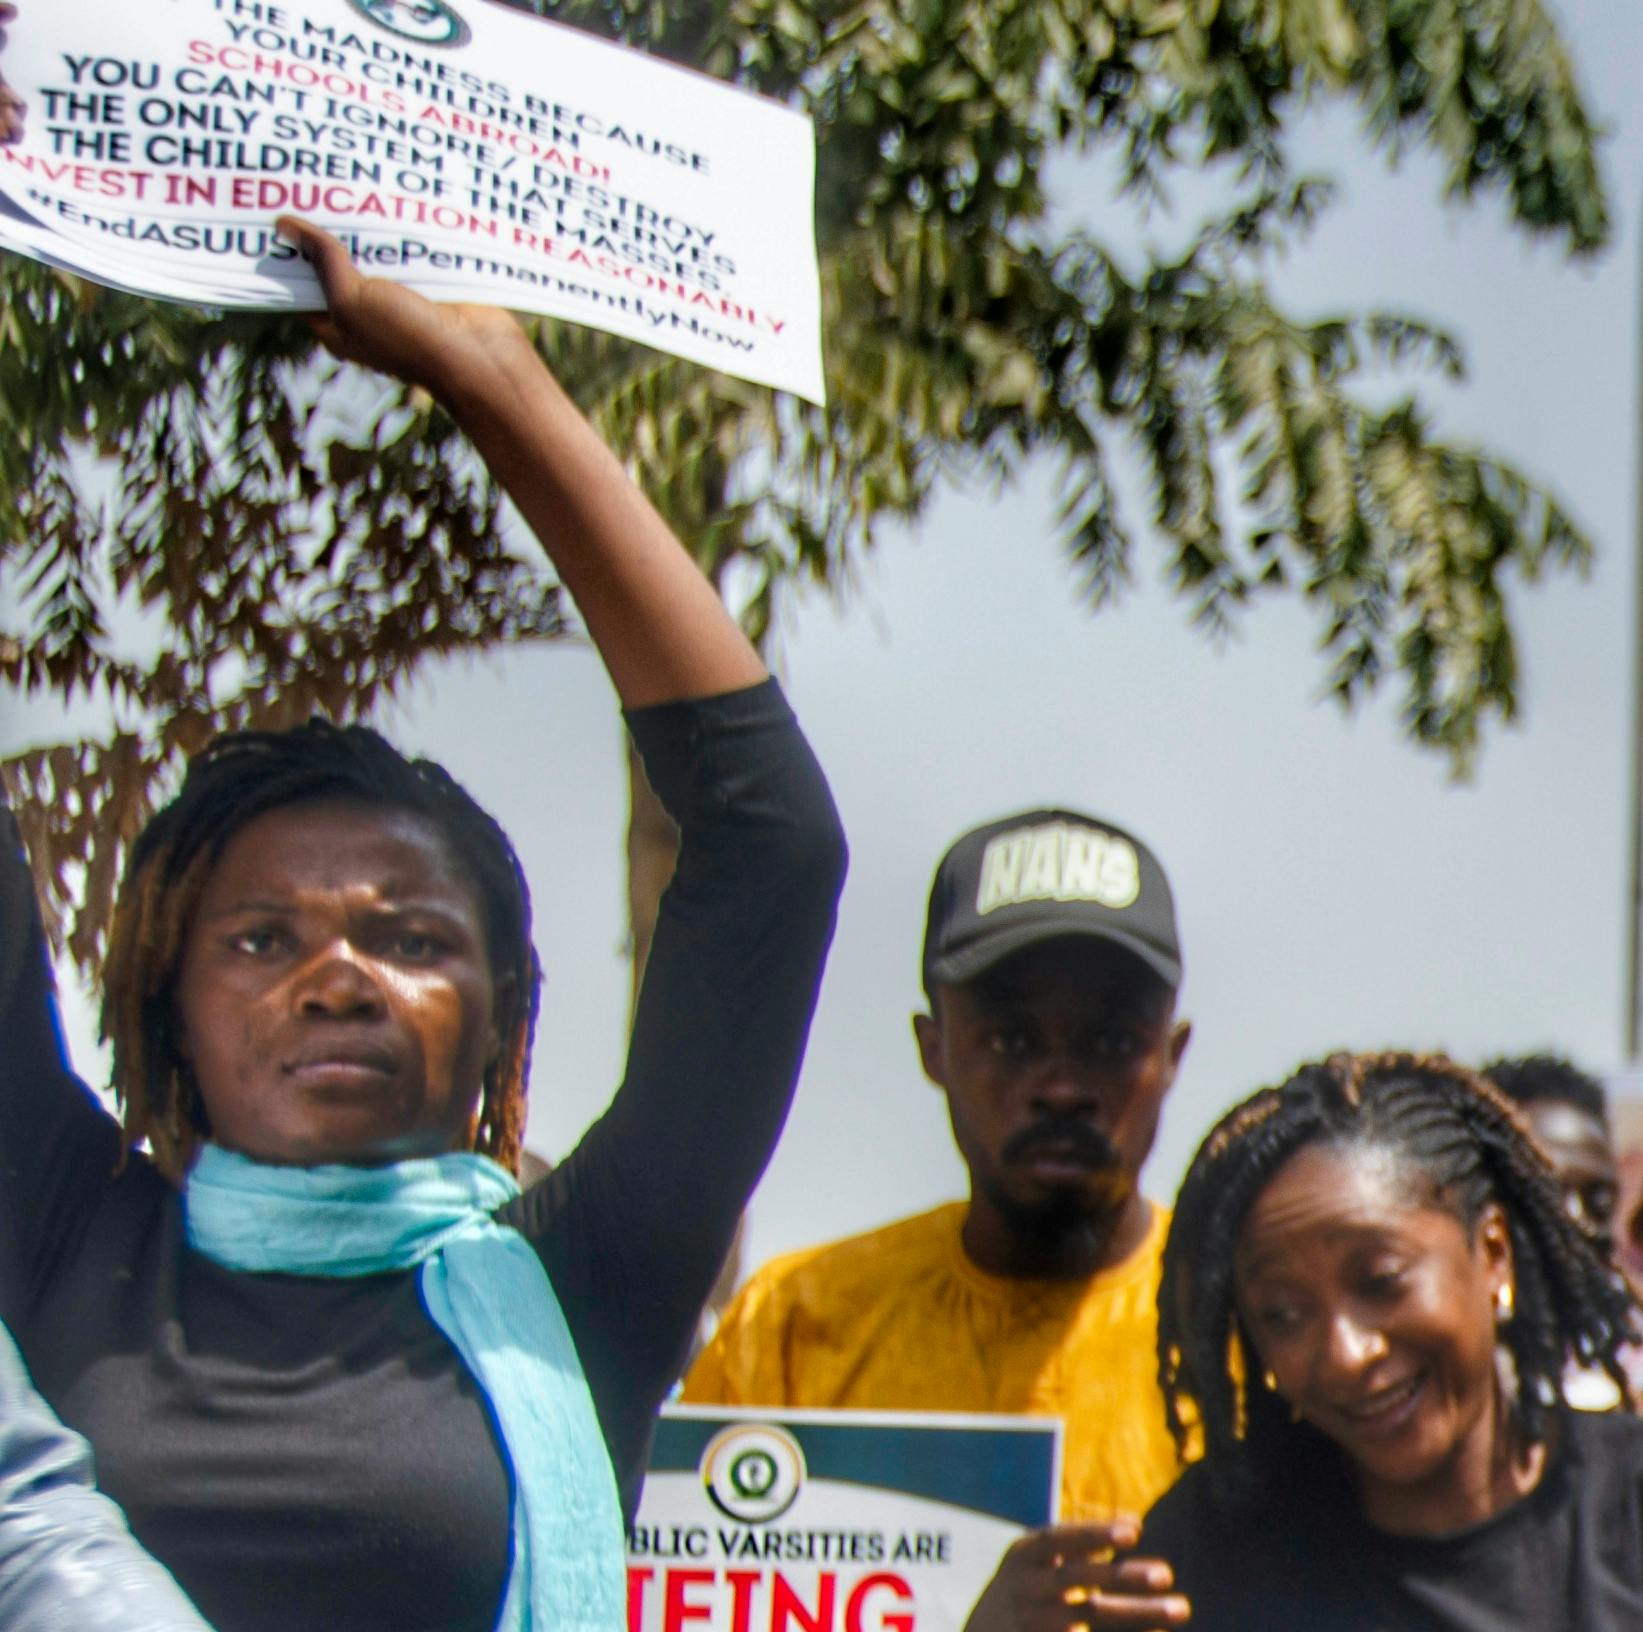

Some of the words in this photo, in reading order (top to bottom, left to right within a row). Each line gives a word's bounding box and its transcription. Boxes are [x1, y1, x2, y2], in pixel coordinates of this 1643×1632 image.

[187, 39, 406, 114] SCHOOLS
[418, 103, 612, 183] ABROAD!
[224, 18, 347, 71] YOUR
[361, 62, 581, 149] CHILDREN
[302, 17, 511, 103] MADNESS
[524, 93, 711, 176] BECAUSE
[0, 143, 154, 201] NVEST
[164, 172, 216, 208] IN
[231, 177, 499, 238] EDUCATION
[38, 87, 127, 125] THE
[137, 97, 261, 135] ONLY
[273, 114, 445, 172] SYSTEM
[468, 164, 570, 217] THAT
[582, 207, 737, 276] SERVES
[45, 126, 131, 163] THE
[145, 134, 382, 184] CHILDREN
[395, 170, 455, 198] OF
[466, 187, 541, 229] THE
[62, 53, 161, 90] YOU
[174, 67, 307, 113] CAN'T
[532, 164, 716, 247] DESTROY
[976, 819, 1140, 916] NANS
[628, 1527, 710, 1557] BLIC
[718, 1528, 885, 1562] VARSITIES
[891, 1532, 951, 1563] ARE
